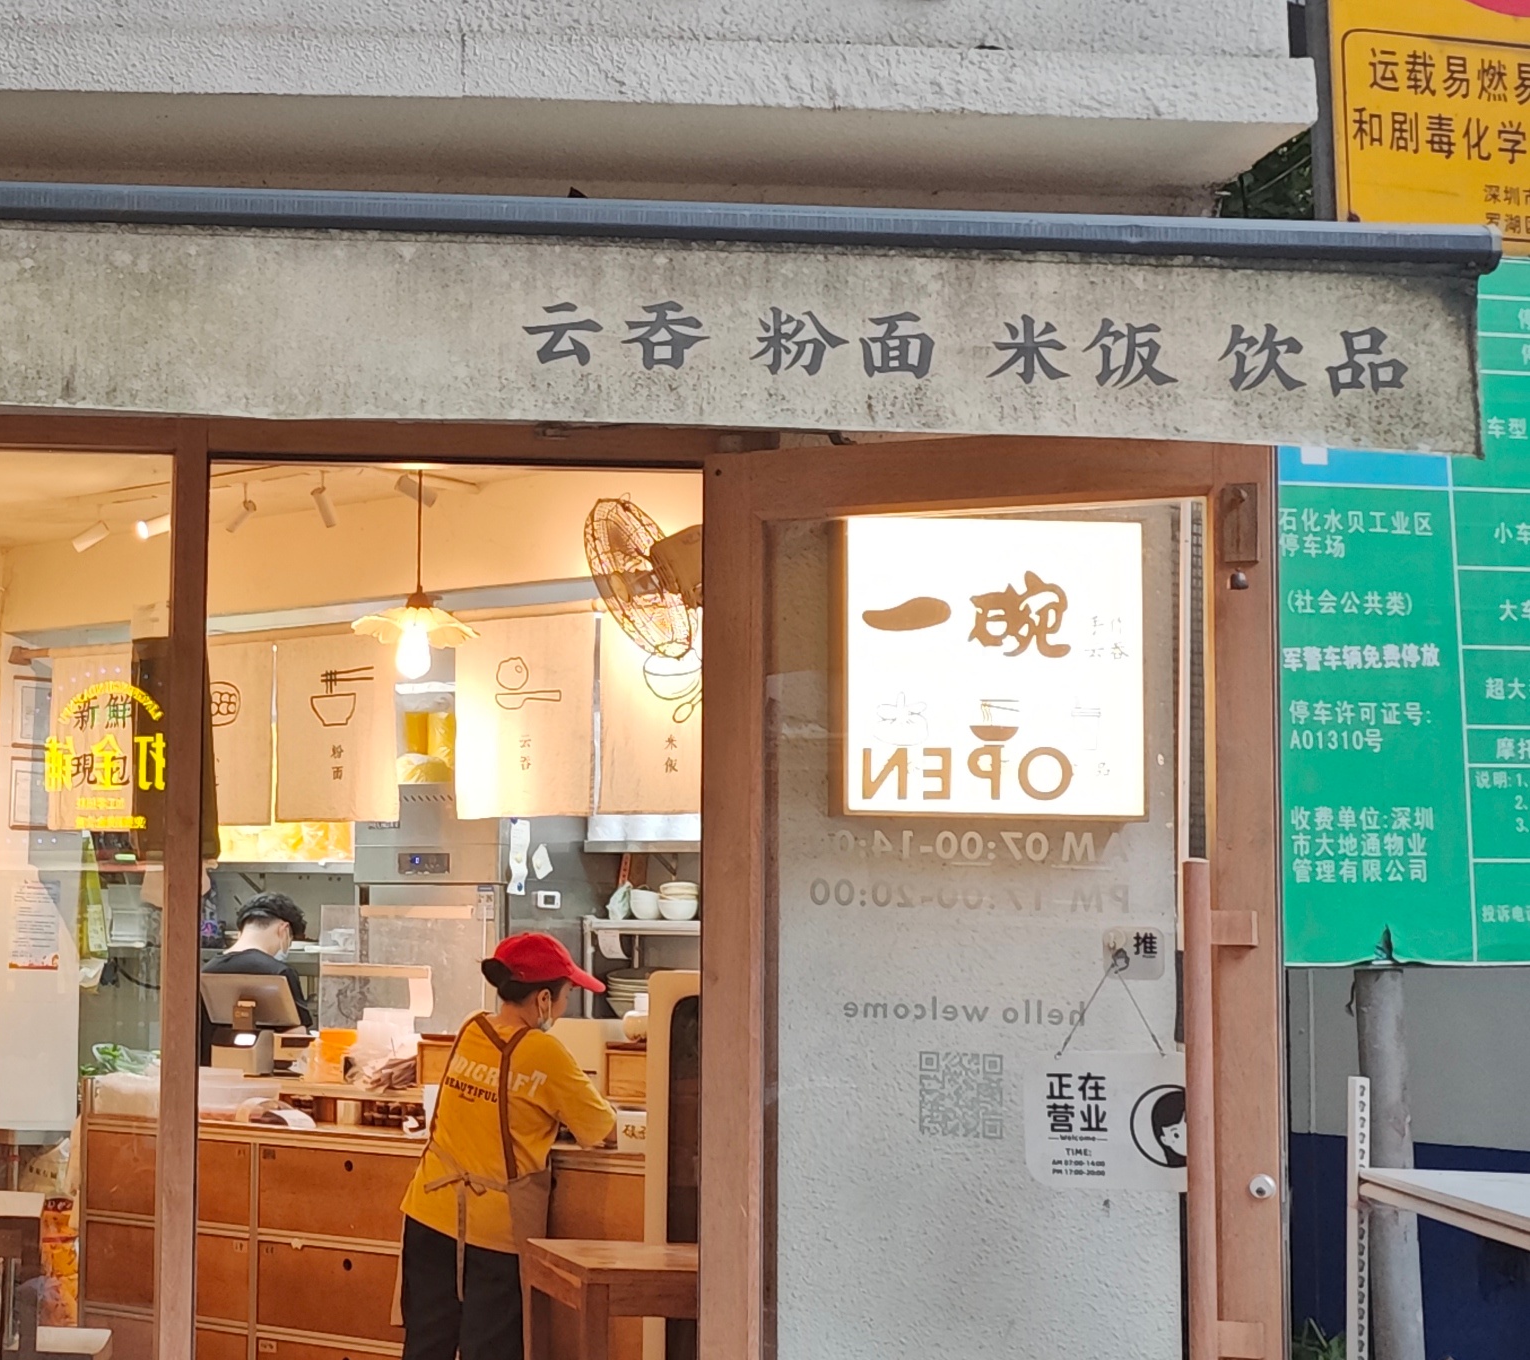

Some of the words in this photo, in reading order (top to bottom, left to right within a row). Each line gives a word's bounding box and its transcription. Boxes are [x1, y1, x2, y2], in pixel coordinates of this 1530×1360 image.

[1352, 107, 1527, 164] 和剧毒化学
[523, 301, 711, 371] 云吞
[751, 306, 936, 380] 粉面
[987, 313, 1179, 386] 米饭
[1217, 323, 1409, 397] 饮品
[1487, 416, 1528, 439] 车型
[1278, 507, 1433, 536] 石化水贝工业区
[1278, 533, 1346, 558] 停车场
[861, 570, 1072, 659] 一碗
[1287, 589, 1413, 616] (社会公共类)
[1485, 677, 1530, 700] 超大
[1290, 728, 1383, 753] A01310号
[1290, 806, 1434, 831] 收费单位:深圳
[1291, 832, 1427, 857] 市大地通物业
[1292, 858, 1427, 883] 管理有限公司
[1481, 905, 1530, 923] 投诉电
[1133, 931, 1157, 955] 推
[1046, 1072, 1107, 1101] 正在
[1046, 1103, 1108, 1132] 营业
[1065, 1147, 1092, 1157] TIME:
